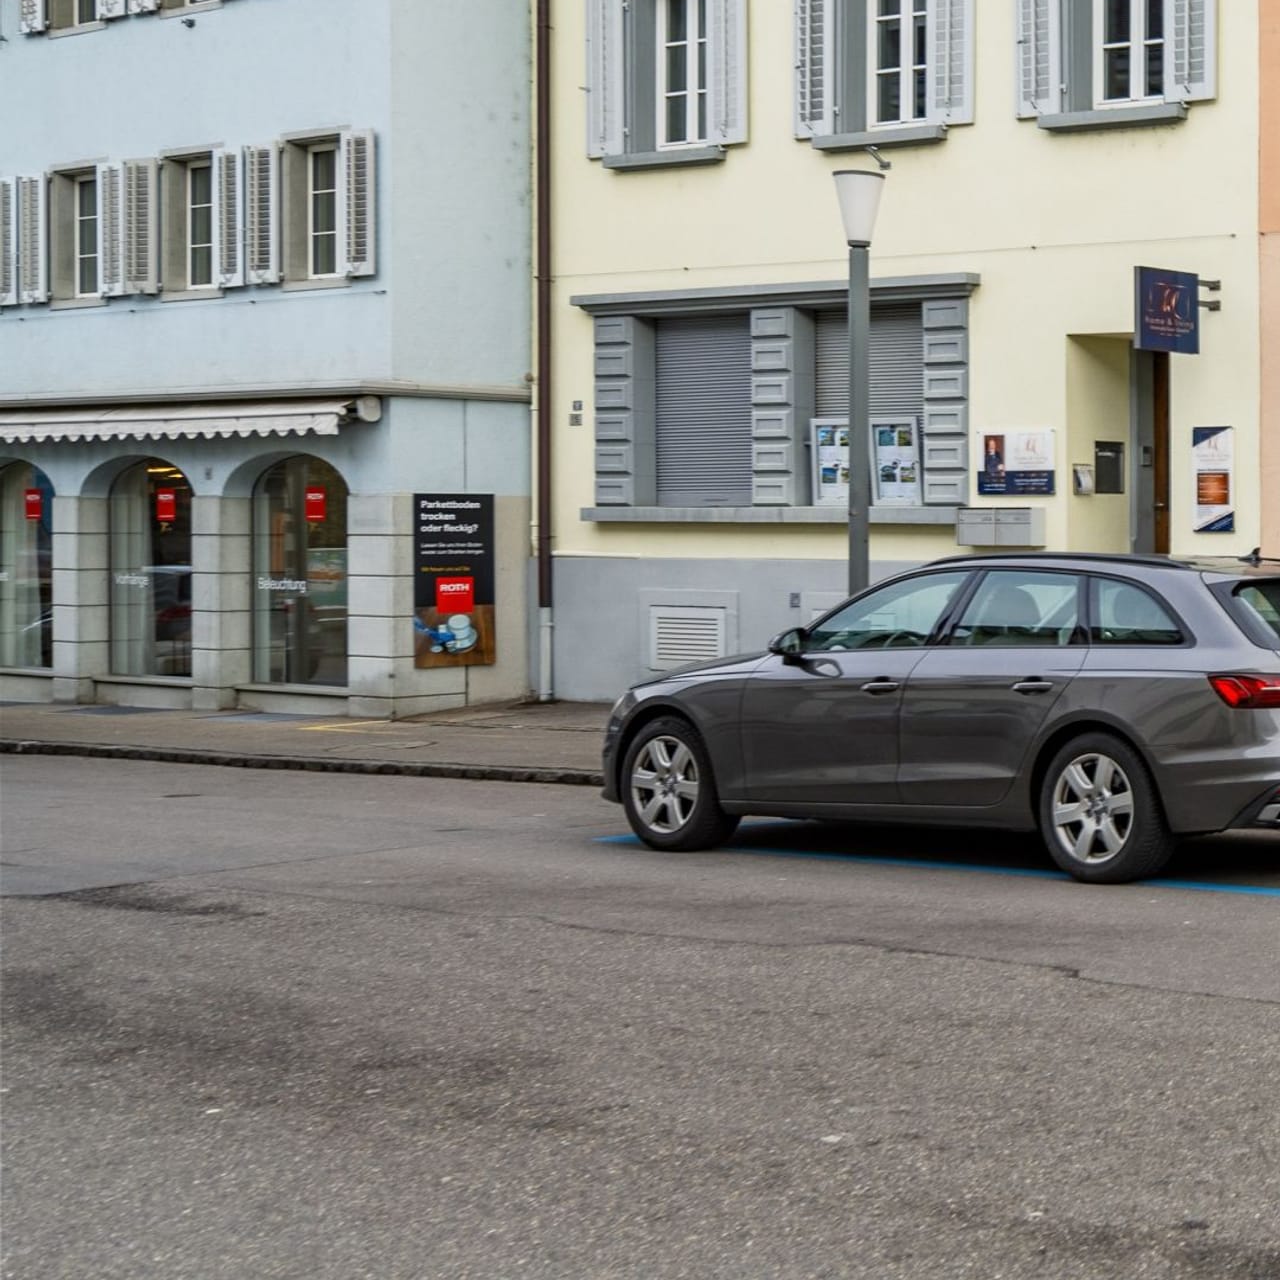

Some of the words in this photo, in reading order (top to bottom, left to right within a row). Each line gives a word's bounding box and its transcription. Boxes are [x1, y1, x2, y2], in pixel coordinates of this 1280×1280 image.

[420, 500, 481, 509] Parkettboden
[420, 512, 456, 521] trocken
[420, 524, 442, 533] oder
[444, 524, 479, 534] fleckig?
[257, 576, 307, 593] Beleuchtung
[439, 583, 470, 592] ROTH
